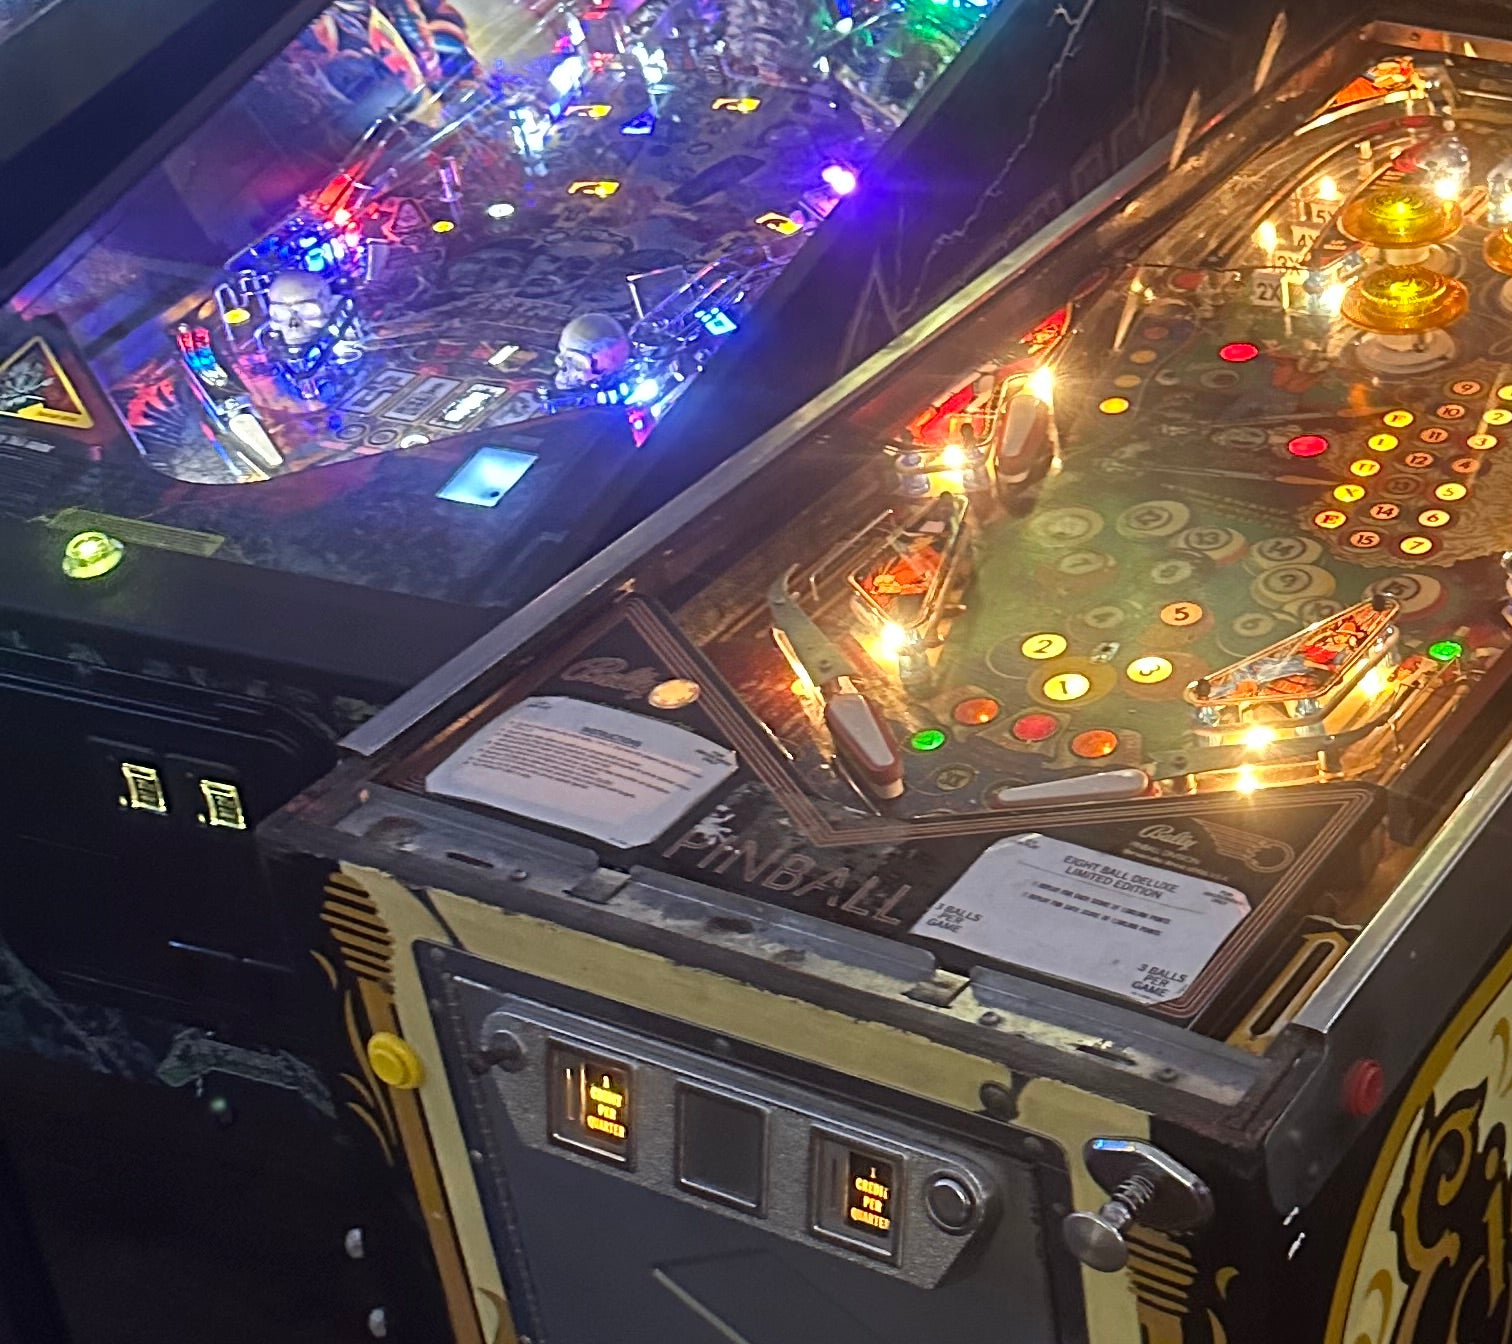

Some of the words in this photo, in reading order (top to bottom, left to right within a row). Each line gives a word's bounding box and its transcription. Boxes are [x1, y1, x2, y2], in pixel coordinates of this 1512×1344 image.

[1461, 384, 1474, 393] 9
[1442, 407, 1461, 417] 10
[1493, 412, 1505, 421] 2
[1475, 438, 1488, 447] 3
[1410, 455, 1429, 465] 12
[1442, 488, 1454, 497] 5
[1375, 506, 1395, 517] 14
[1426, 513, 1440, 523] 6
[1323, 514, 1340, 525] E
[1356, 535, 1374, 545] 15
[1409, 540, 1425, 550] 7
[1174, 606, 1190, 622] 5
[1033, 639, 1054, 654] 2
[1139, 663, 1161, 677] 3
[1059, 680, 1068, 695] 1
[1138, 824, 1198, 851] Bally
[663, 826, 912, 926] PINBALL
[1063, 855, 1100, 872] EIGHT
[1100, 865, 1130, 880] BALL
[1129, 874, 1180, 894] DELUXE
[1064, 866, 1113, 892] LIMITED
[1112, 878, 1164, 900] EDITION
[944, 905, 984, 922] BALLS
[926, 918, 963, 933] GAME
[1137, 964, 1149, 972] 3
[1148, 966, 1188, 983] BALLS
[1143, 975, 1170, 987] PER
[1131, 981, 1170, 997] GAME
[855, 1177, 889, 1200] CREDIT
[862, 1195, 883, 1213] PER
[850, 1206, 891, 1230] QUARTER
